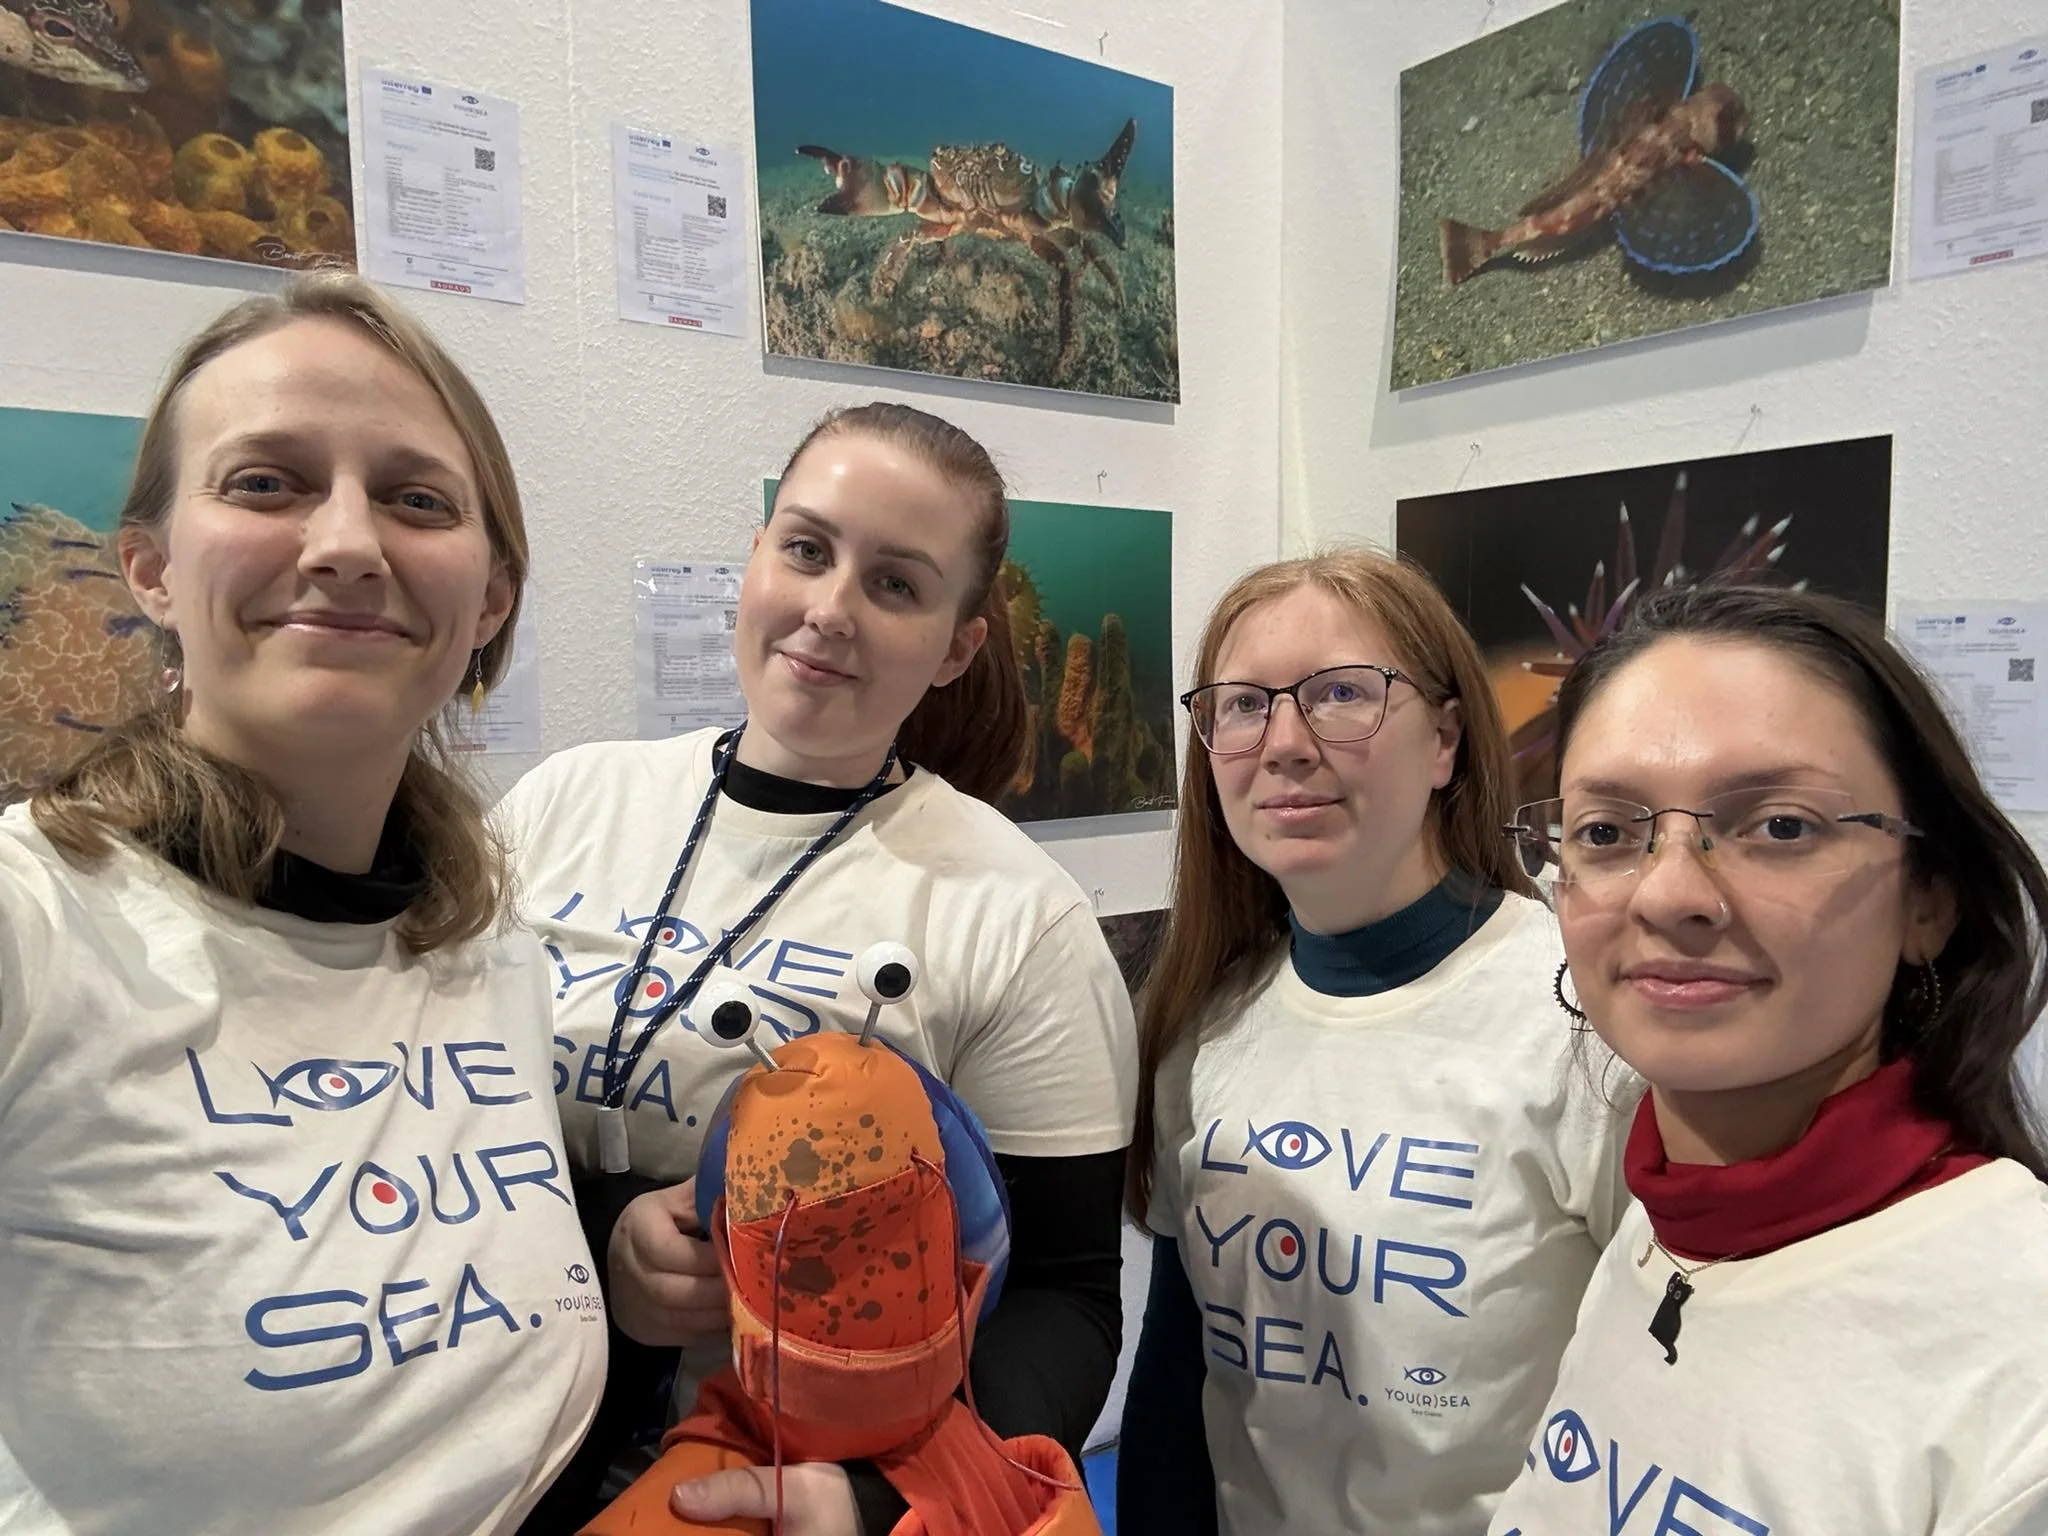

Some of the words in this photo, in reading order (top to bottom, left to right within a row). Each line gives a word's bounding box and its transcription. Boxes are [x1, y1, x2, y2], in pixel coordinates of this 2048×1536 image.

[185, 1041, 532, 1126] LOVE
[212, 1141, 573, 1241] YOUR
[1201, 1118, 1479, 1209] LOVE
[1196, 1205, 1470, 1318] YOUR
[244, 1263, 542, 1391] SEA.
[1206, 1302, 1369, 1406] SEA.
[1384, 1388, 1470, 1408] YOU(R)SEA
